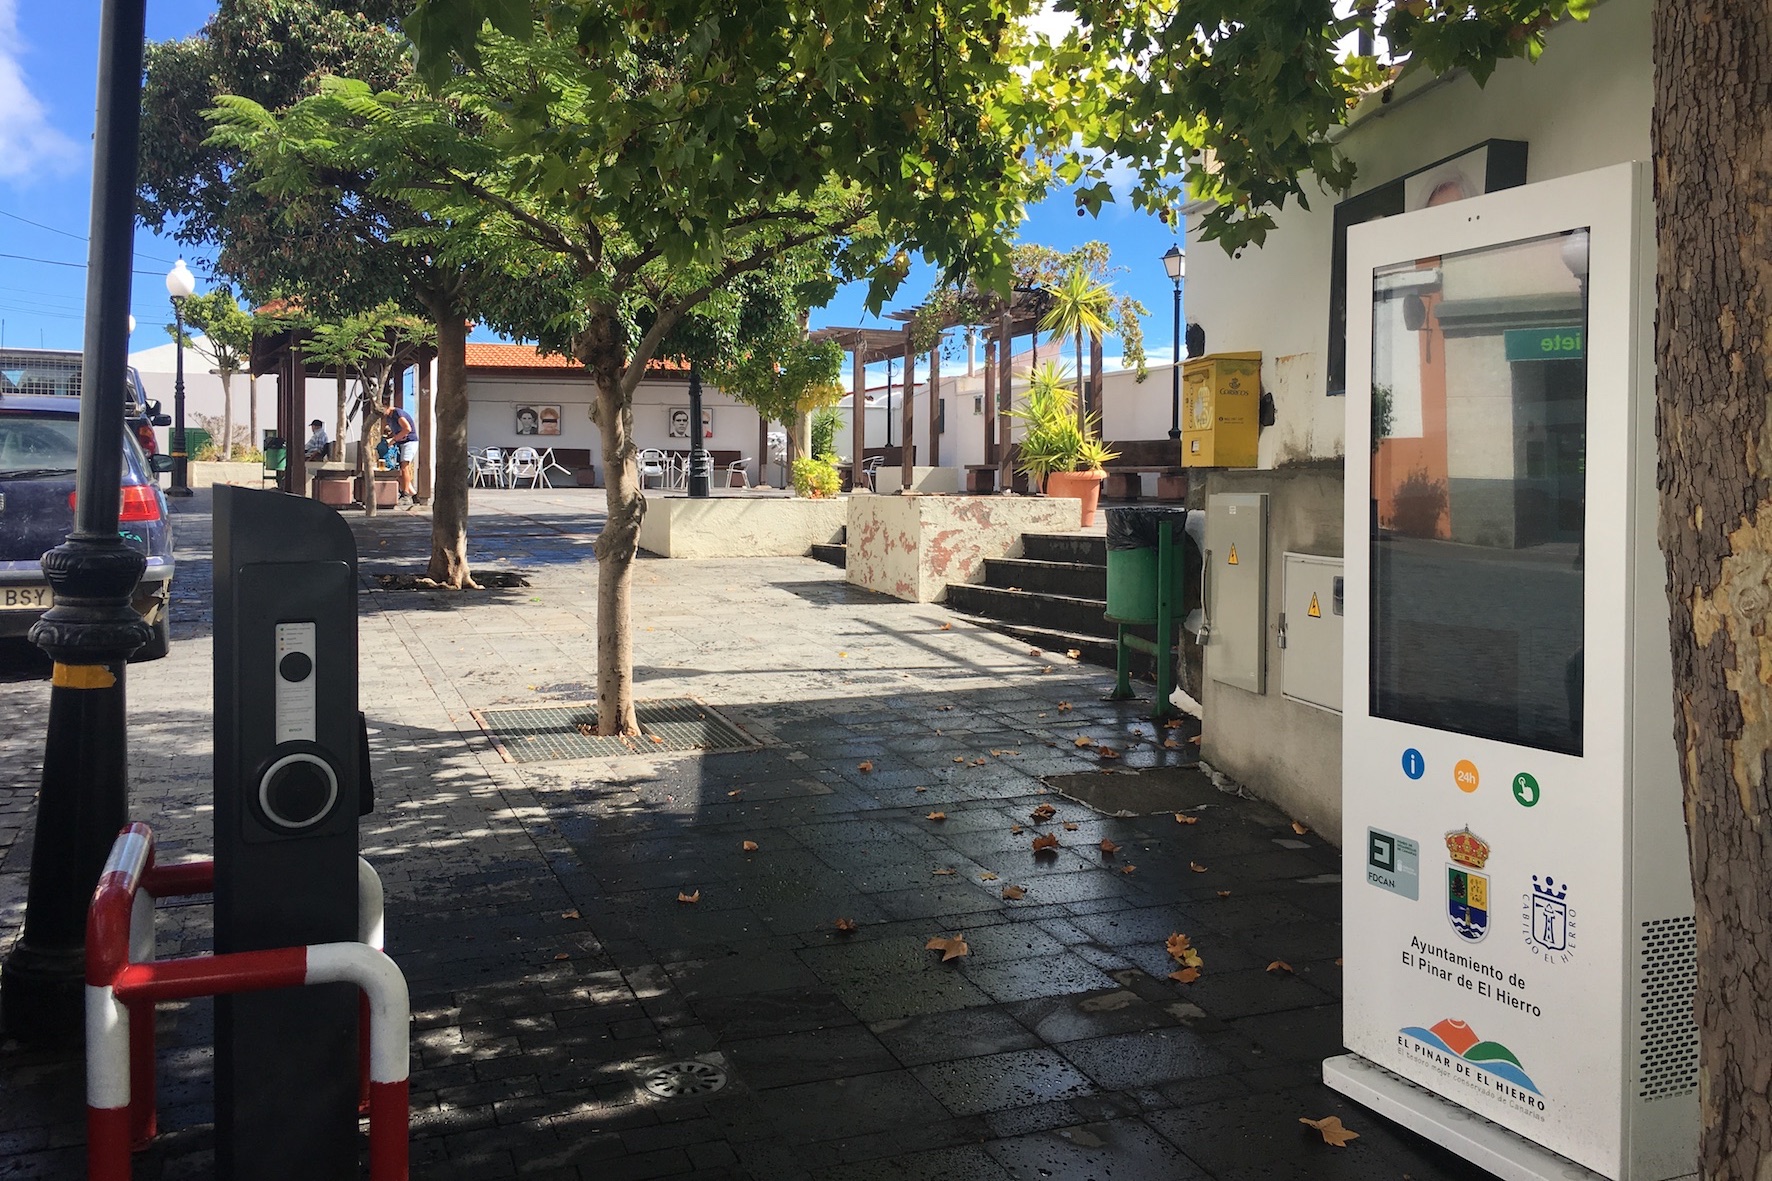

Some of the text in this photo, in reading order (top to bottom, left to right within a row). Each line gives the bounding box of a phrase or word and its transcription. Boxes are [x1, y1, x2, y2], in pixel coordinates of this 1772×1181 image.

[5, 589, 46, 606] BSY
[1457, 770, 1476, 785] 24h
[1368, 871, 1396, 889] FDCAN
[1522, 893, 1577, 965] CABILDO EL HIERRO
[1402, 951, 1541, 1017] El Pinar de El Hierro
[1411, 935, 1526, 990] Ayuntamiento de
[1397, 1035, 1546, 1111] EL PINAR DE EL HIERRO
